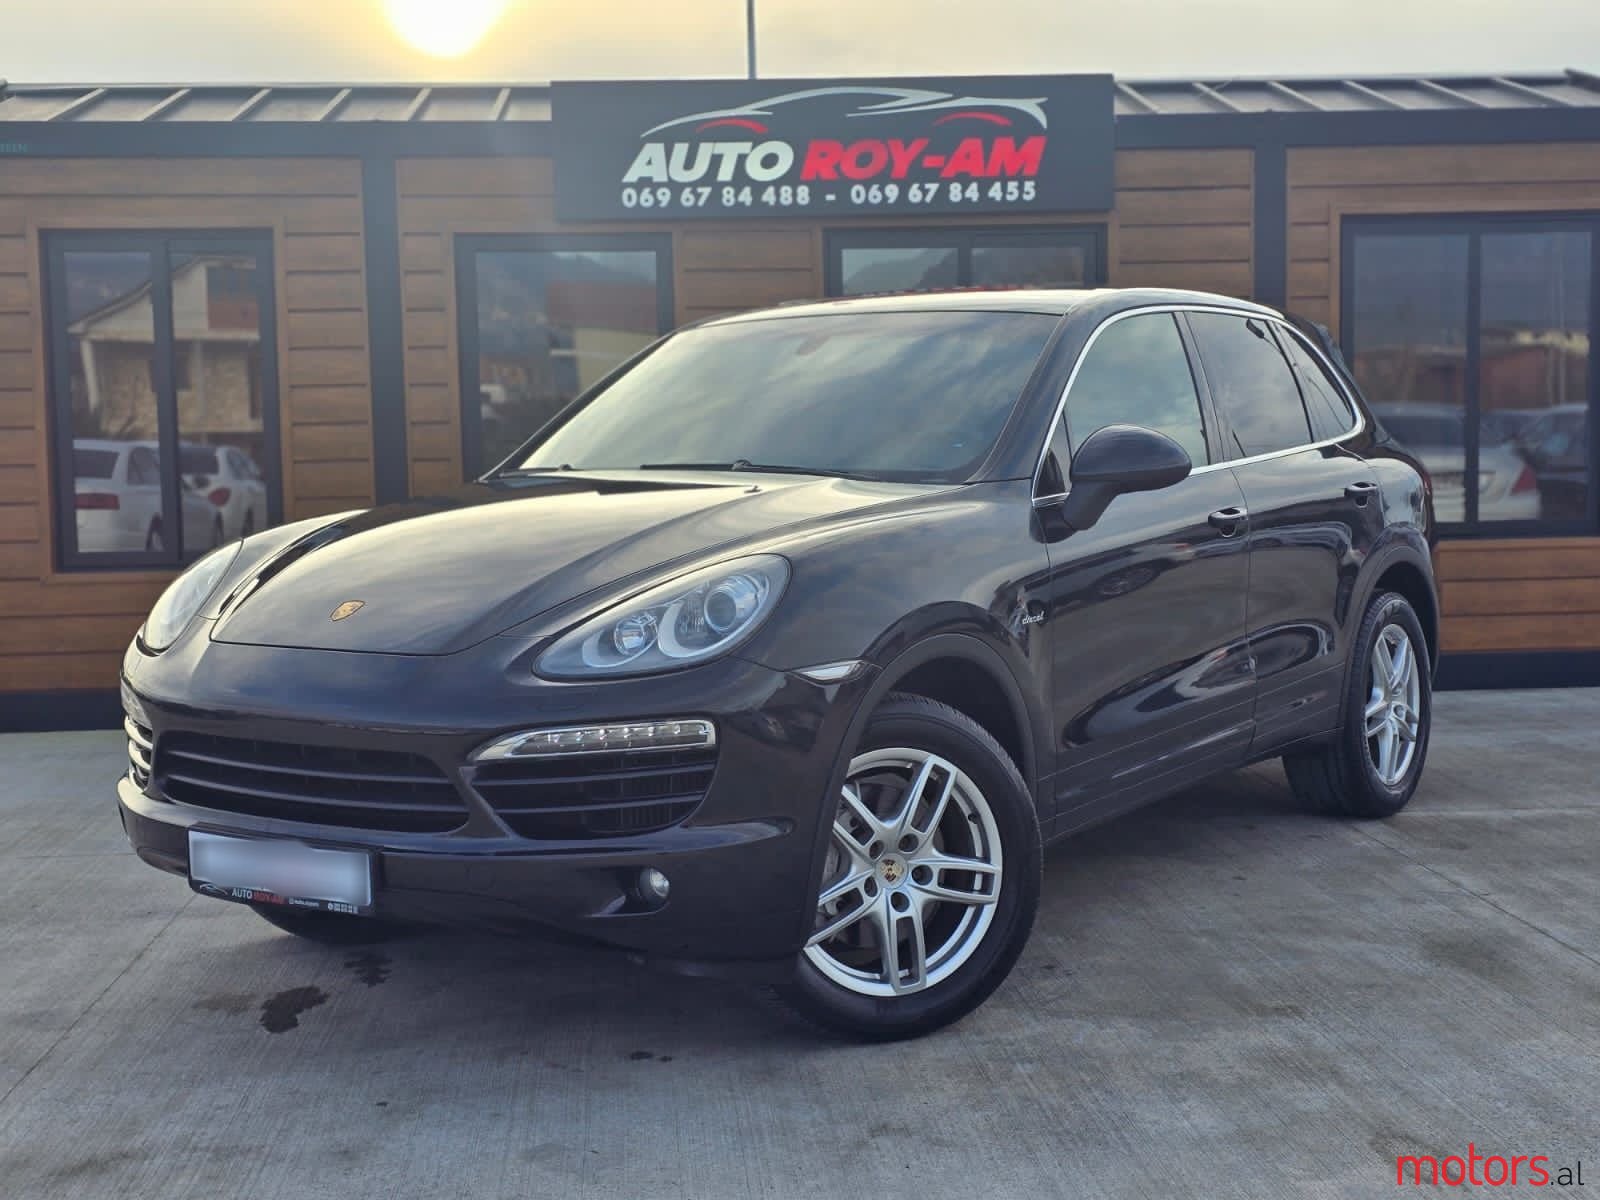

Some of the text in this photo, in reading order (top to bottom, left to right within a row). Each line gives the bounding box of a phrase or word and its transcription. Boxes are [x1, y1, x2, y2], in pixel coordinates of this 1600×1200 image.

[621, 136, 1047, 183] AUTO ROY-AM
[621, 187, 672, 208] 069
[680, 186, 712, 207] 67
[721, 186, 753, 207] 84
[761, 185, 810, 206] 488
[850, 184, 900, 205] 069
[908, 183, 940, 203] 67
[949, 182, 980, 203] 84
[988, 181, 1037, 202] 455
[231, 887, 253, 900] AUTO
